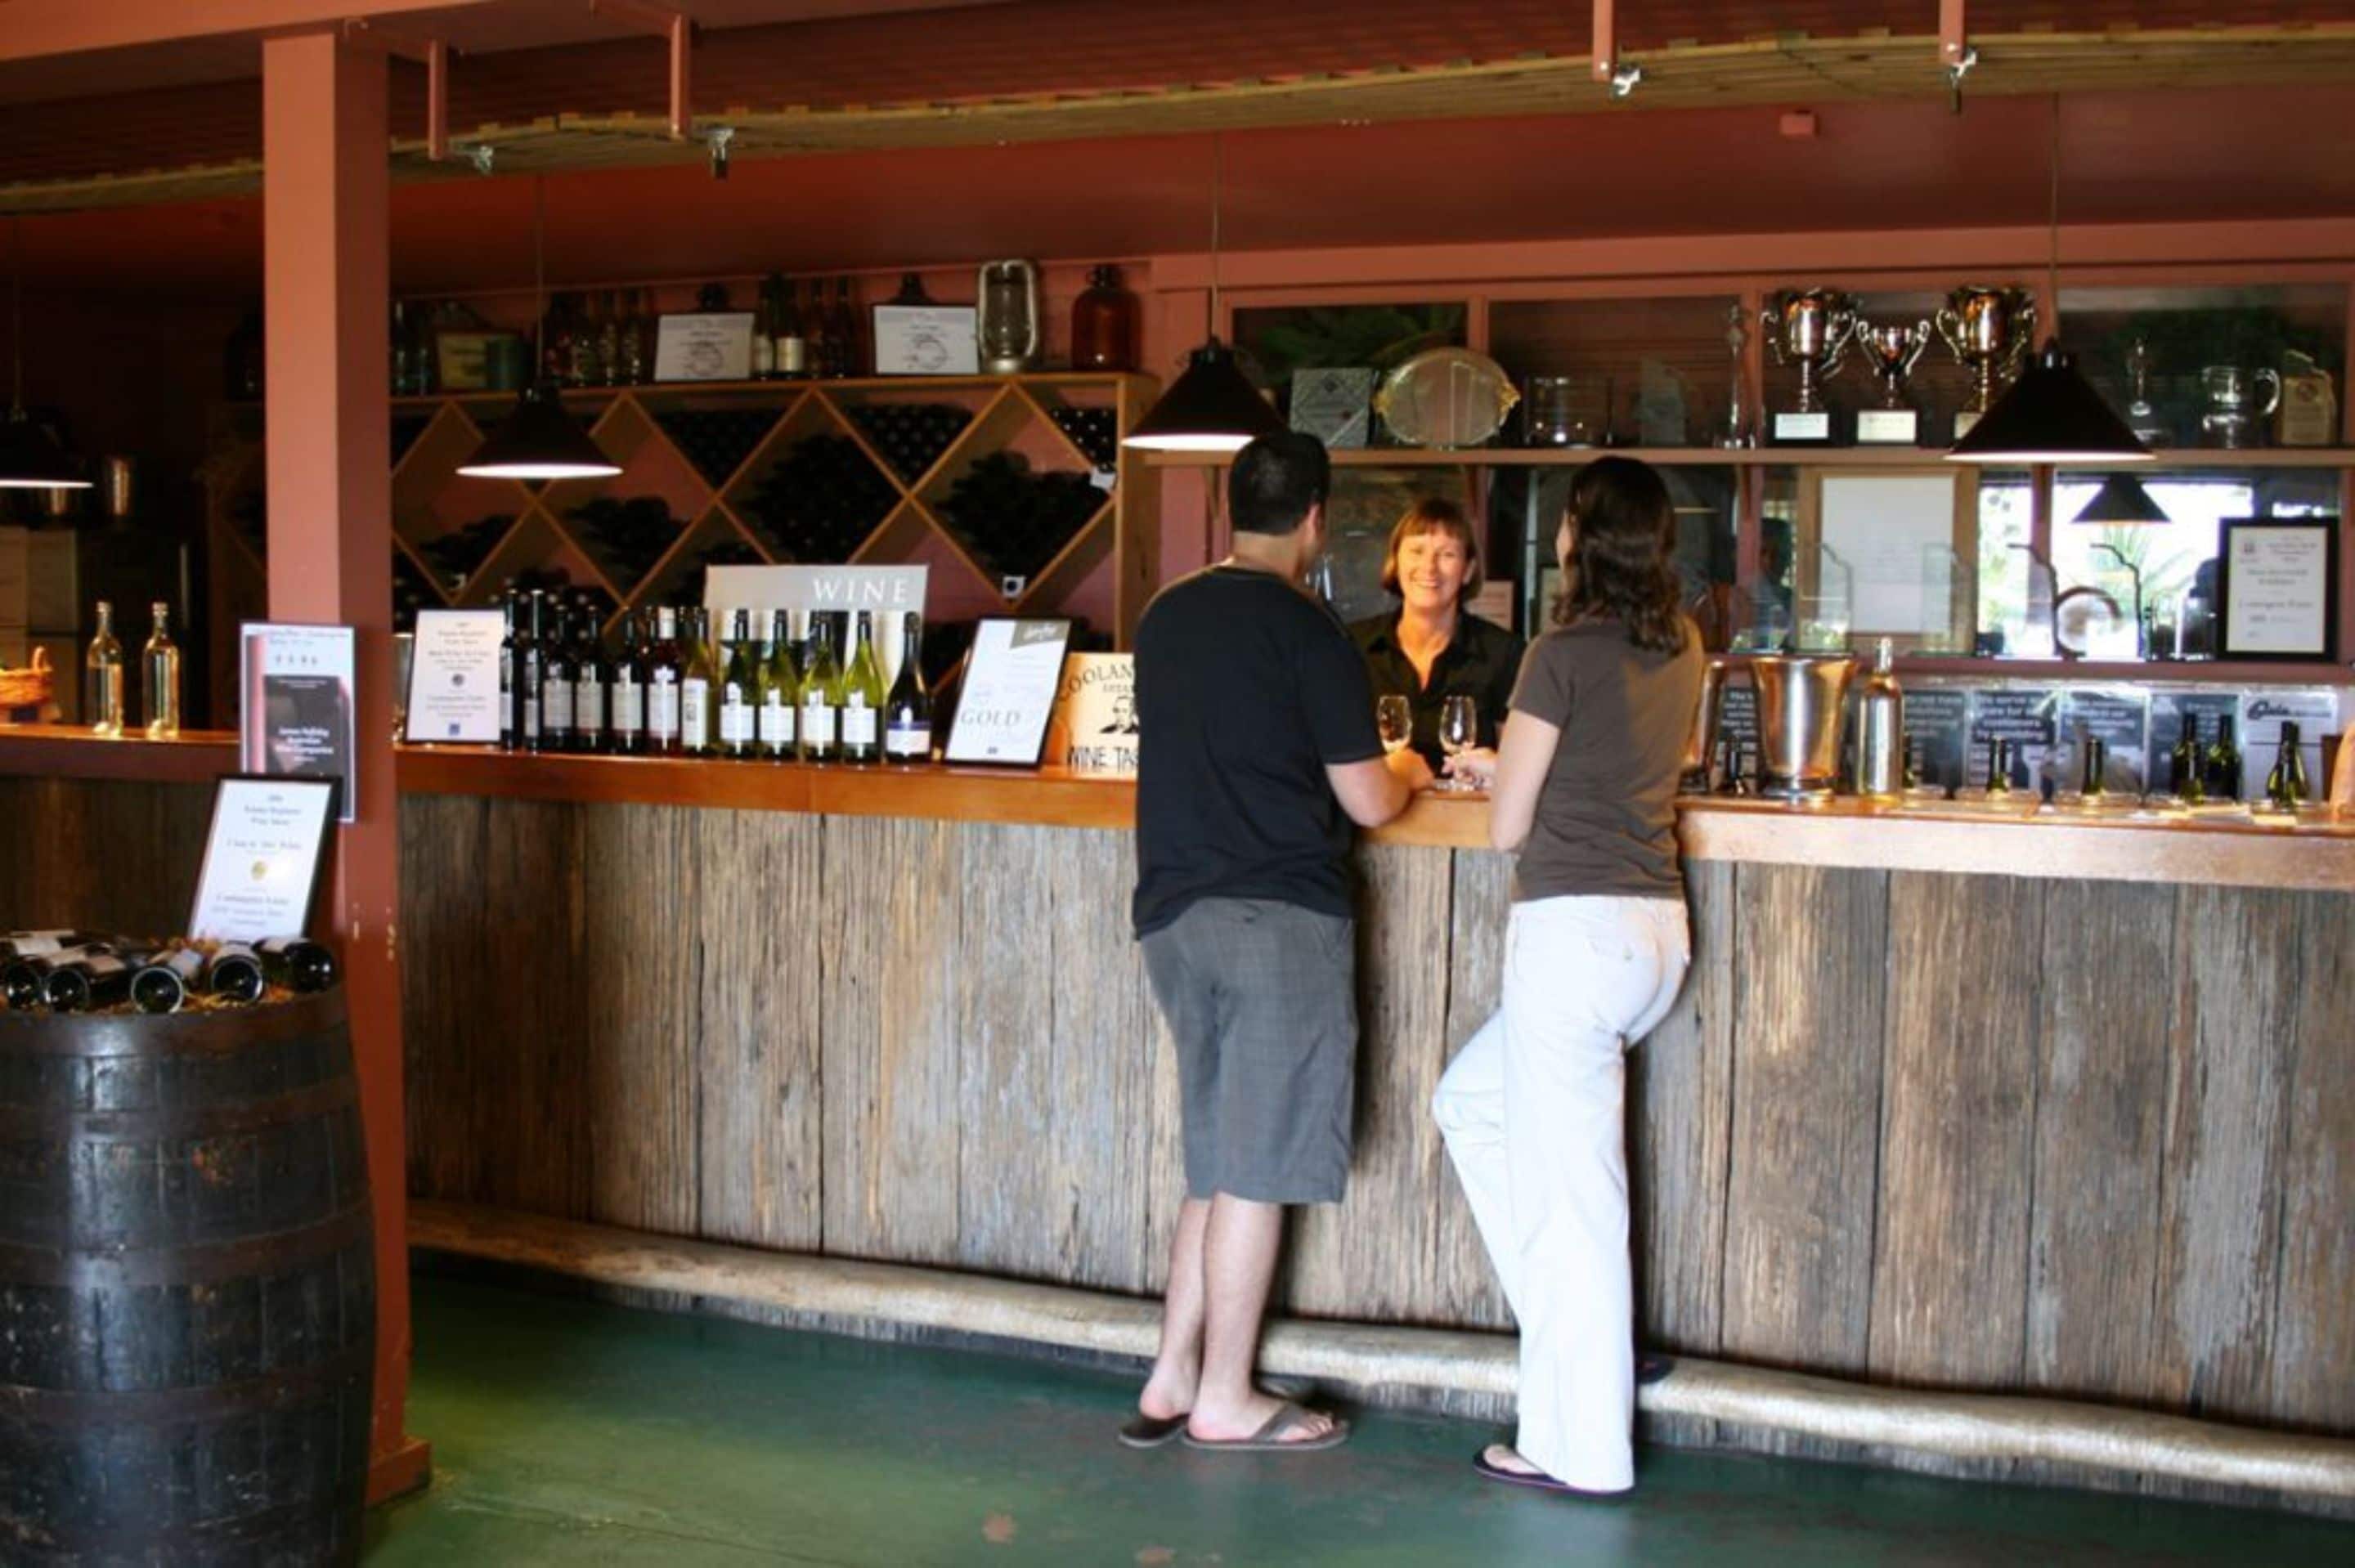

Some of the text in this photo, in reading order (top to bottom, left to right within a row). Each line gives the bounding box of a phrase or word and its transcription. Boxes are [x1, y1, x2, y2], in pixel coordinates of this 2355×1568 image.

[812, 576, 910, 603] WINE
[1058, 663, 1134, 701] OOLAN
[960, 708, 1021, 728] GOLD
[1068, 746, 1139, 772] WINE TA
